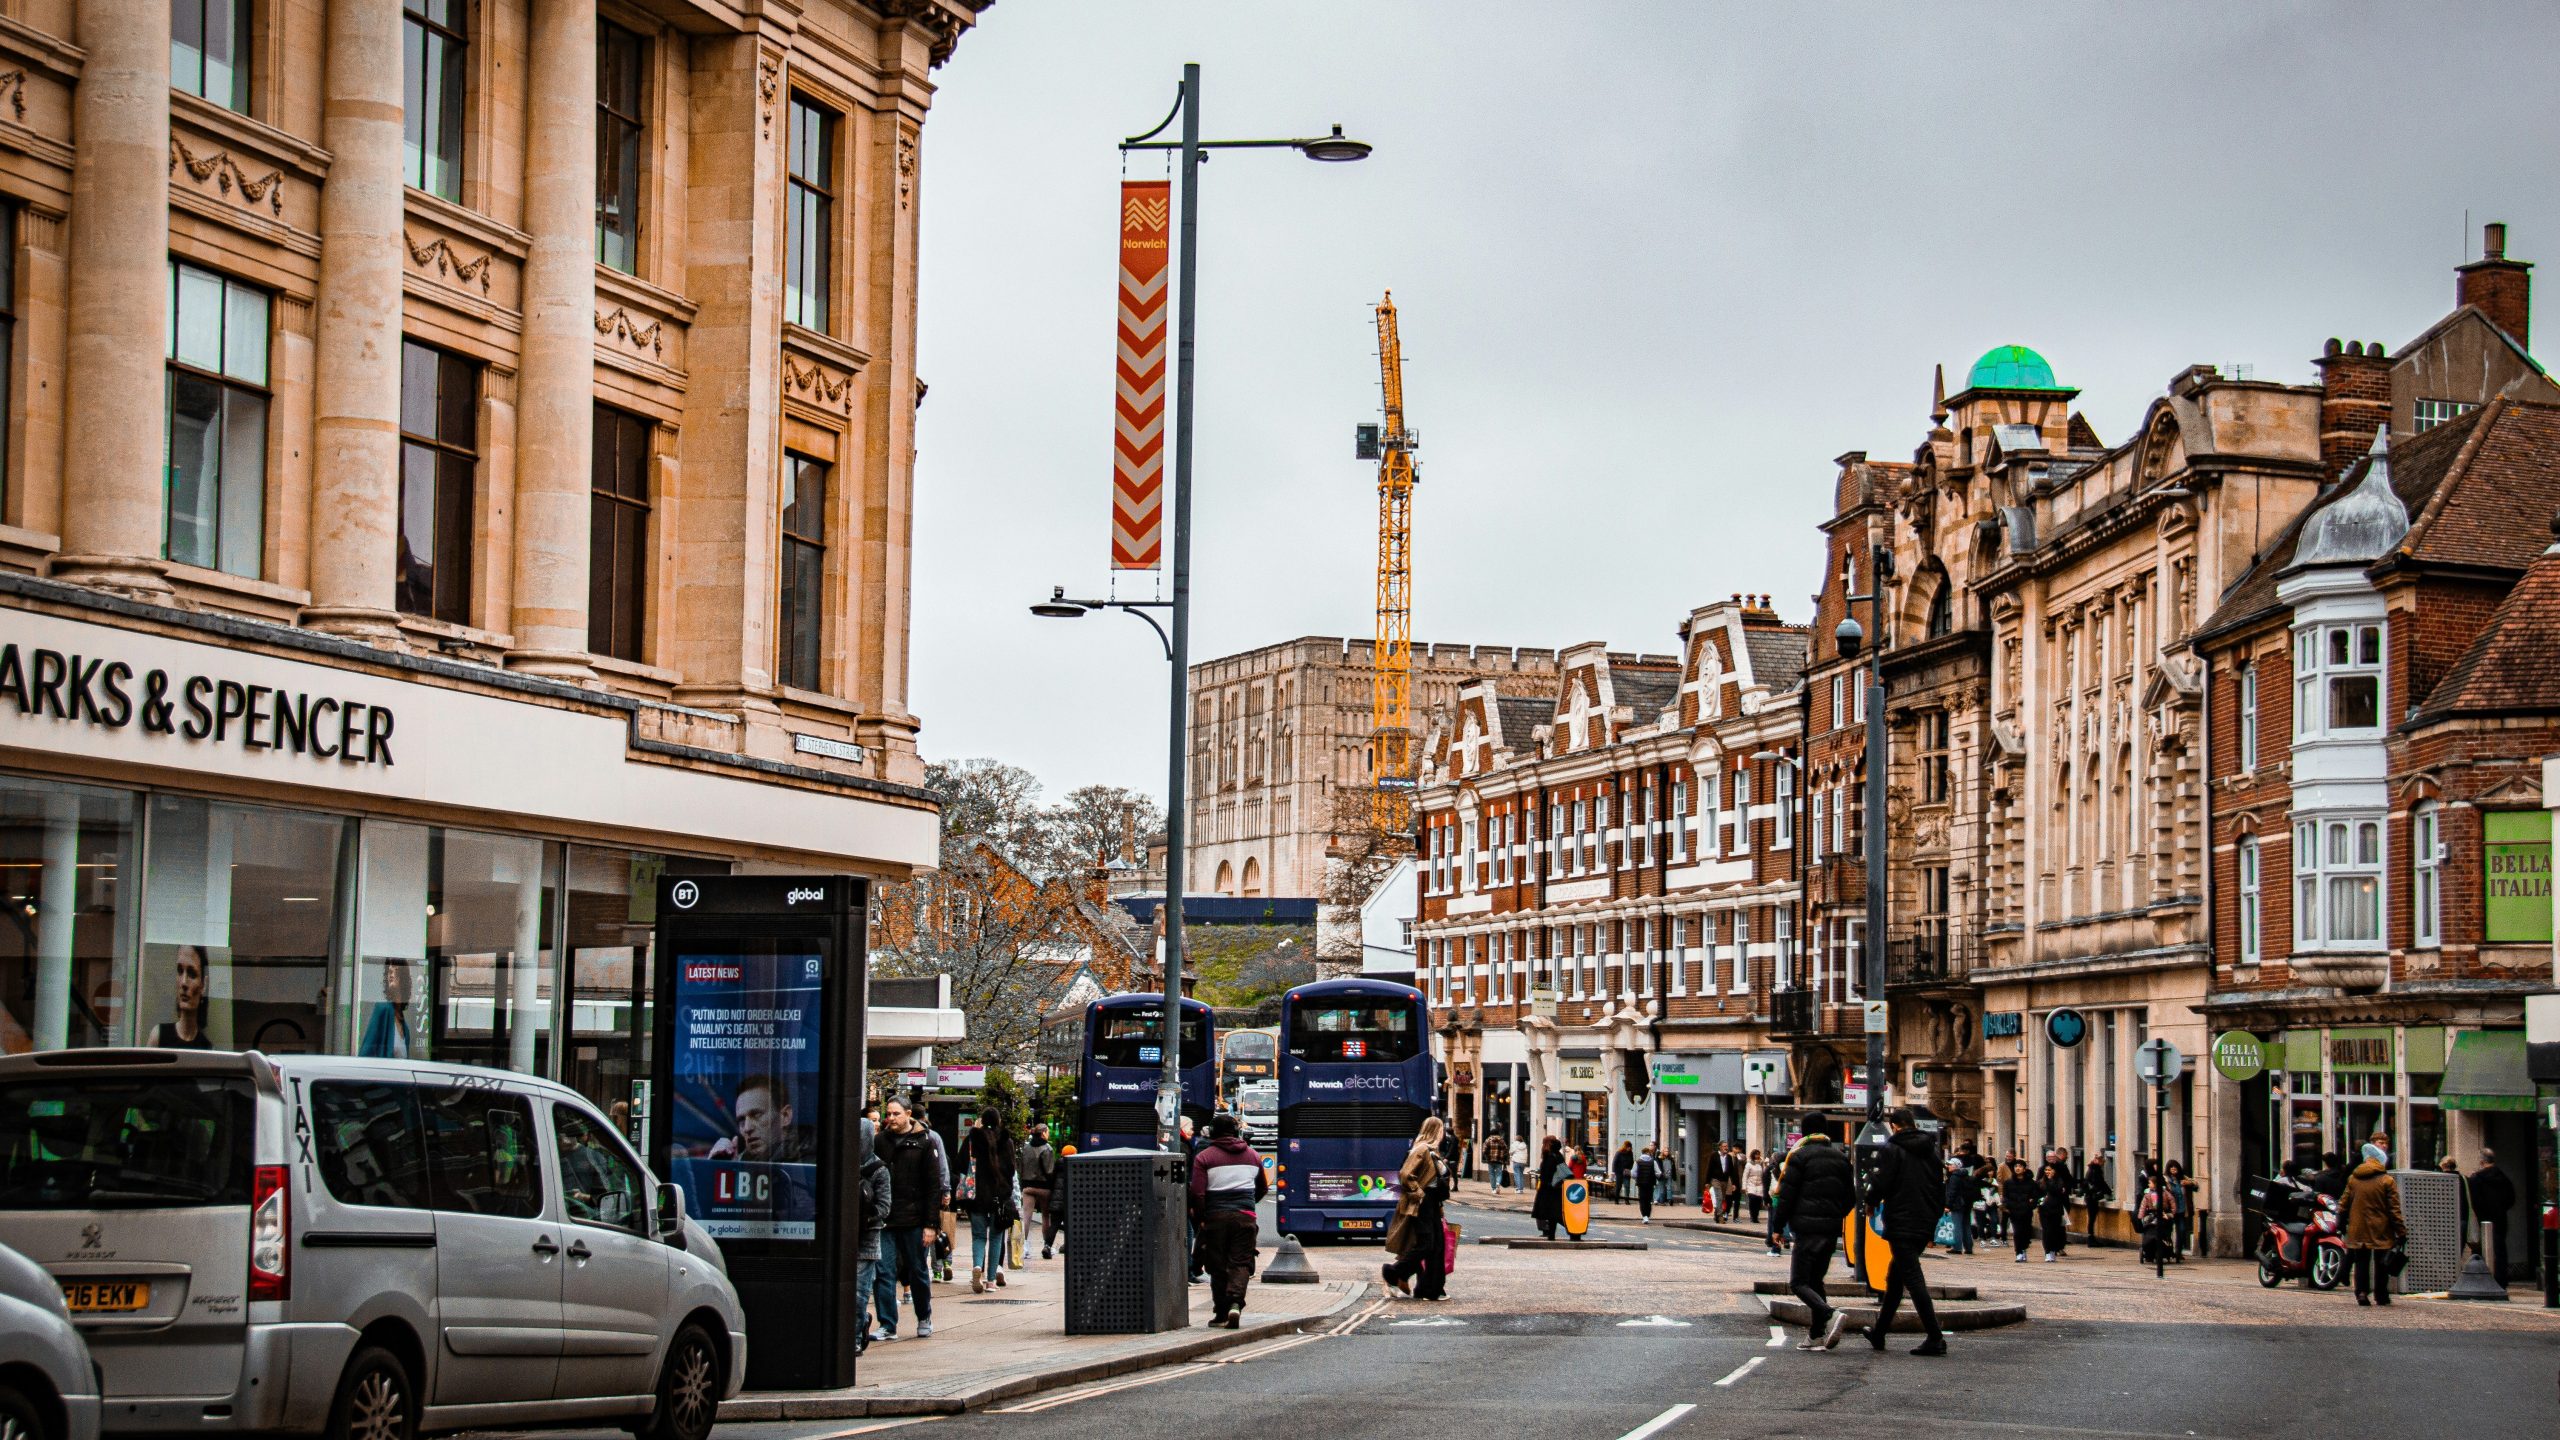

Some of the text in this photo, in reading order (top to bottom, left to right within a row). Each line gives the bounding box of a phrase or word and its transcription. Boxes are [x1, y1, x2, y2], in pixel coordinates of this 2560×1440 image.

[1123, 239, 1167, 248] Norwich
[142, 668, 176, 735] &
[183, 676, 395, 766] SPENCER
[2491, 855, 2552, 874] BELLA
[2490, 878, 2552, 897] ITALIA
[678, 889, 694, 900] BT
[787, 887, 824, 905] global
[689, 967, 739, 979] LATEST NEWS
[716, 1009, 729, 1020] DID
[731, 1009, 746, 1020] NOT
[747, 1009, 774, 1020] ORDER
[774, 1009, 801, 1020] ALEXEI
[690, 1023, 732, 1035] NAVALNY'S
[763, 1023, 774, 1035] US
[690, 1038, 806, 1049] INTELLIGENCE AGENCIES CLAIM
[2221, 1044, 2258, 1055] BELLA
[2221, 1055, 2260, 1067] ITALIA
[1579, 1067, 1594, 1079] SHOES
[448, 1073, 507, 1091] TAXI
[1109, 1082, 1139, 1091] Norwich
[1309, 1073, 1400, 1089] Norwich electric
[289, 1077, 314, 1194] TAXI
[720, 1171, 769, 1201] LBC
[97, 1285, 137, 1306] EKW
